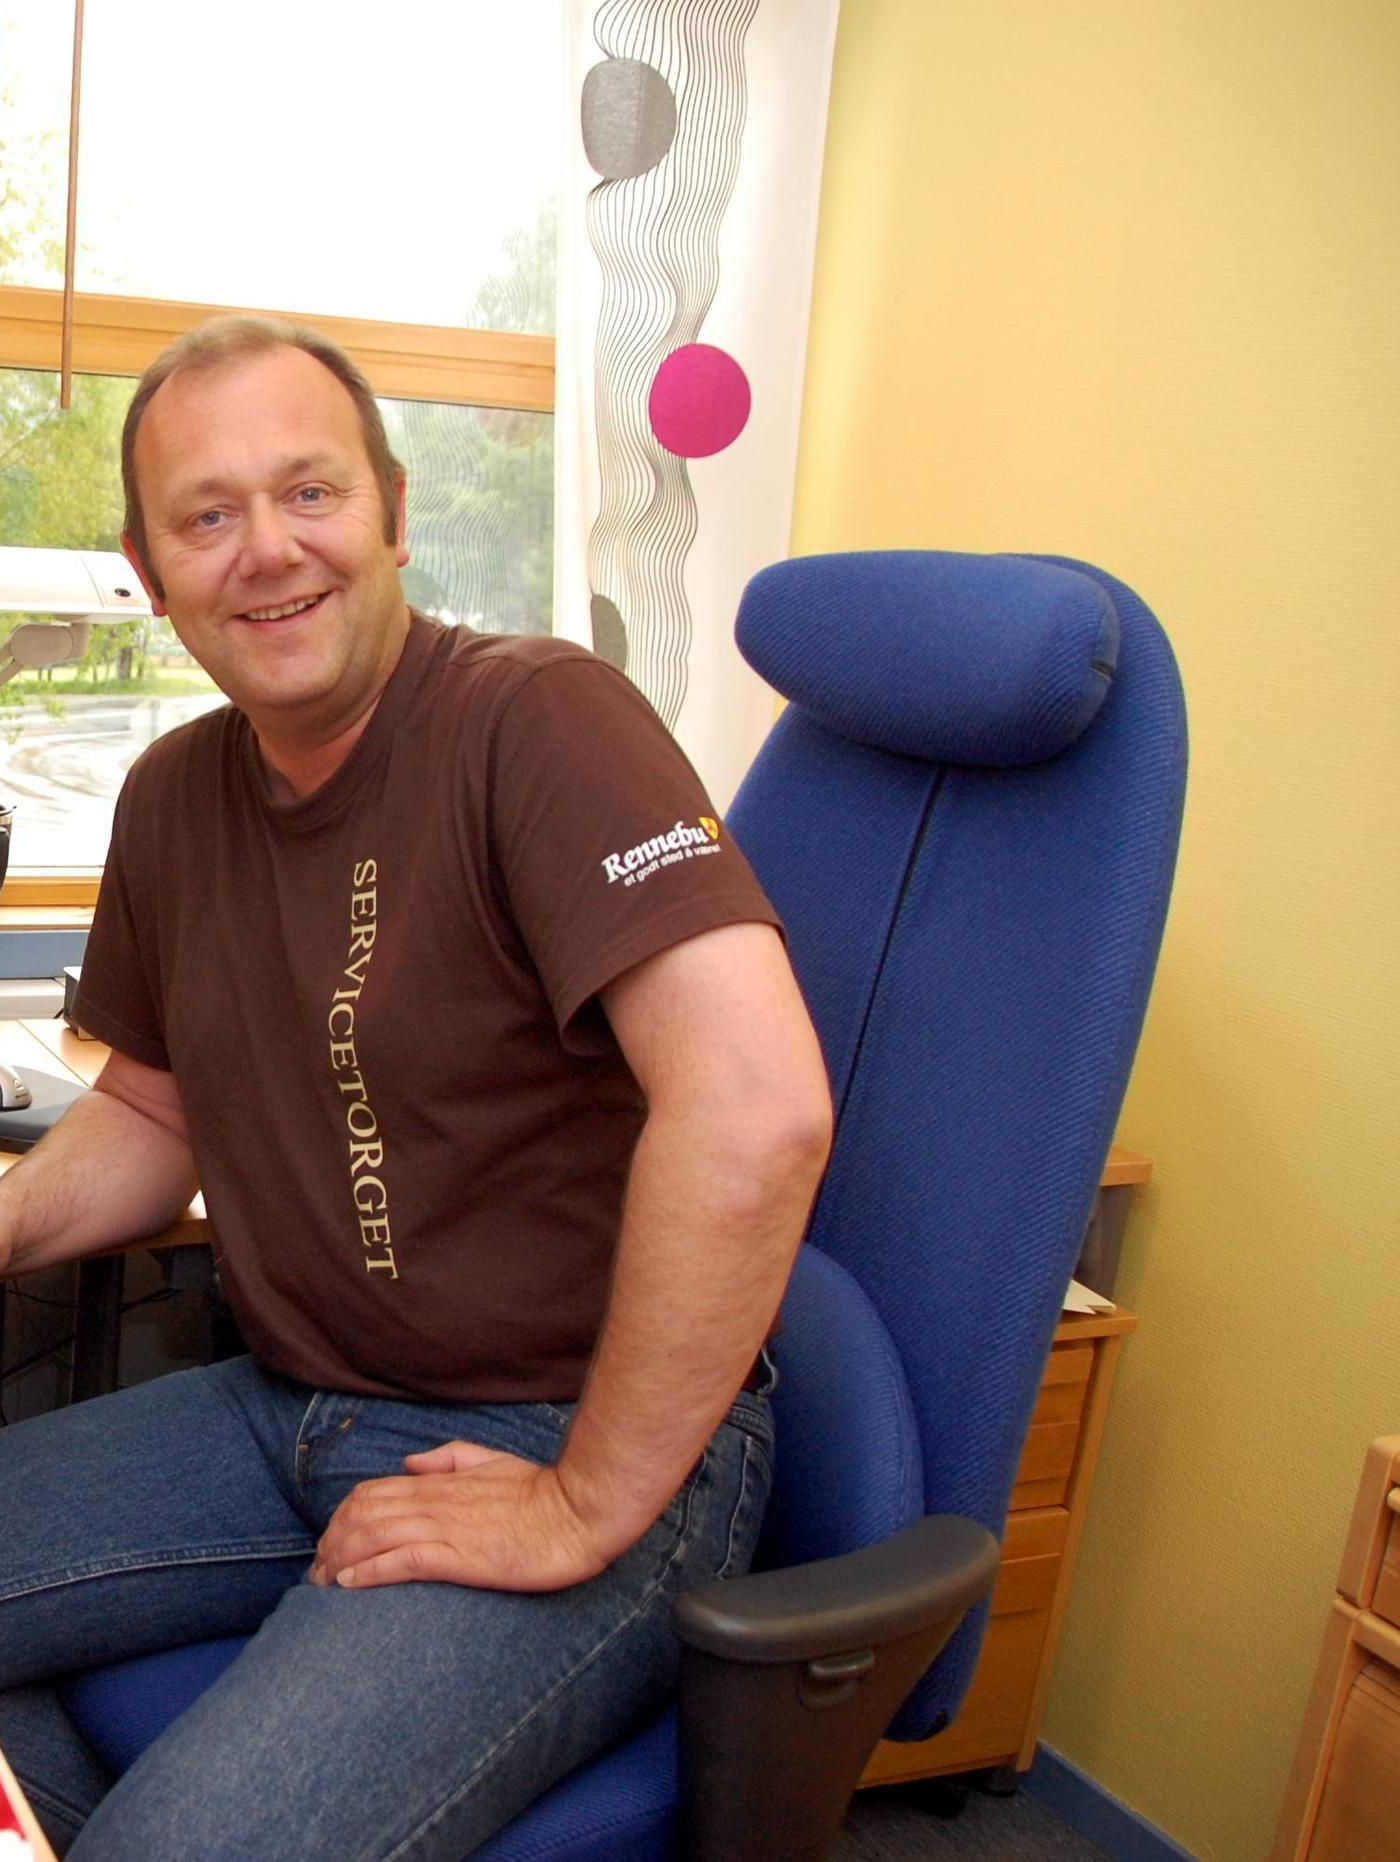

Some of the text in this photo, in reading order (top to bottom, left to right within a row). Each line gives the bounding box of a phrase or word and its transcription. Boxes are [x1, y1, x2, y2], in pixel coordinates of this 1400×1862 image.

[601, 820, 710, 884] Rennebu
[623, 873, 637, 887] et
[636, 860, 660, 882] godt
[660, 849, 684, 866] sted
